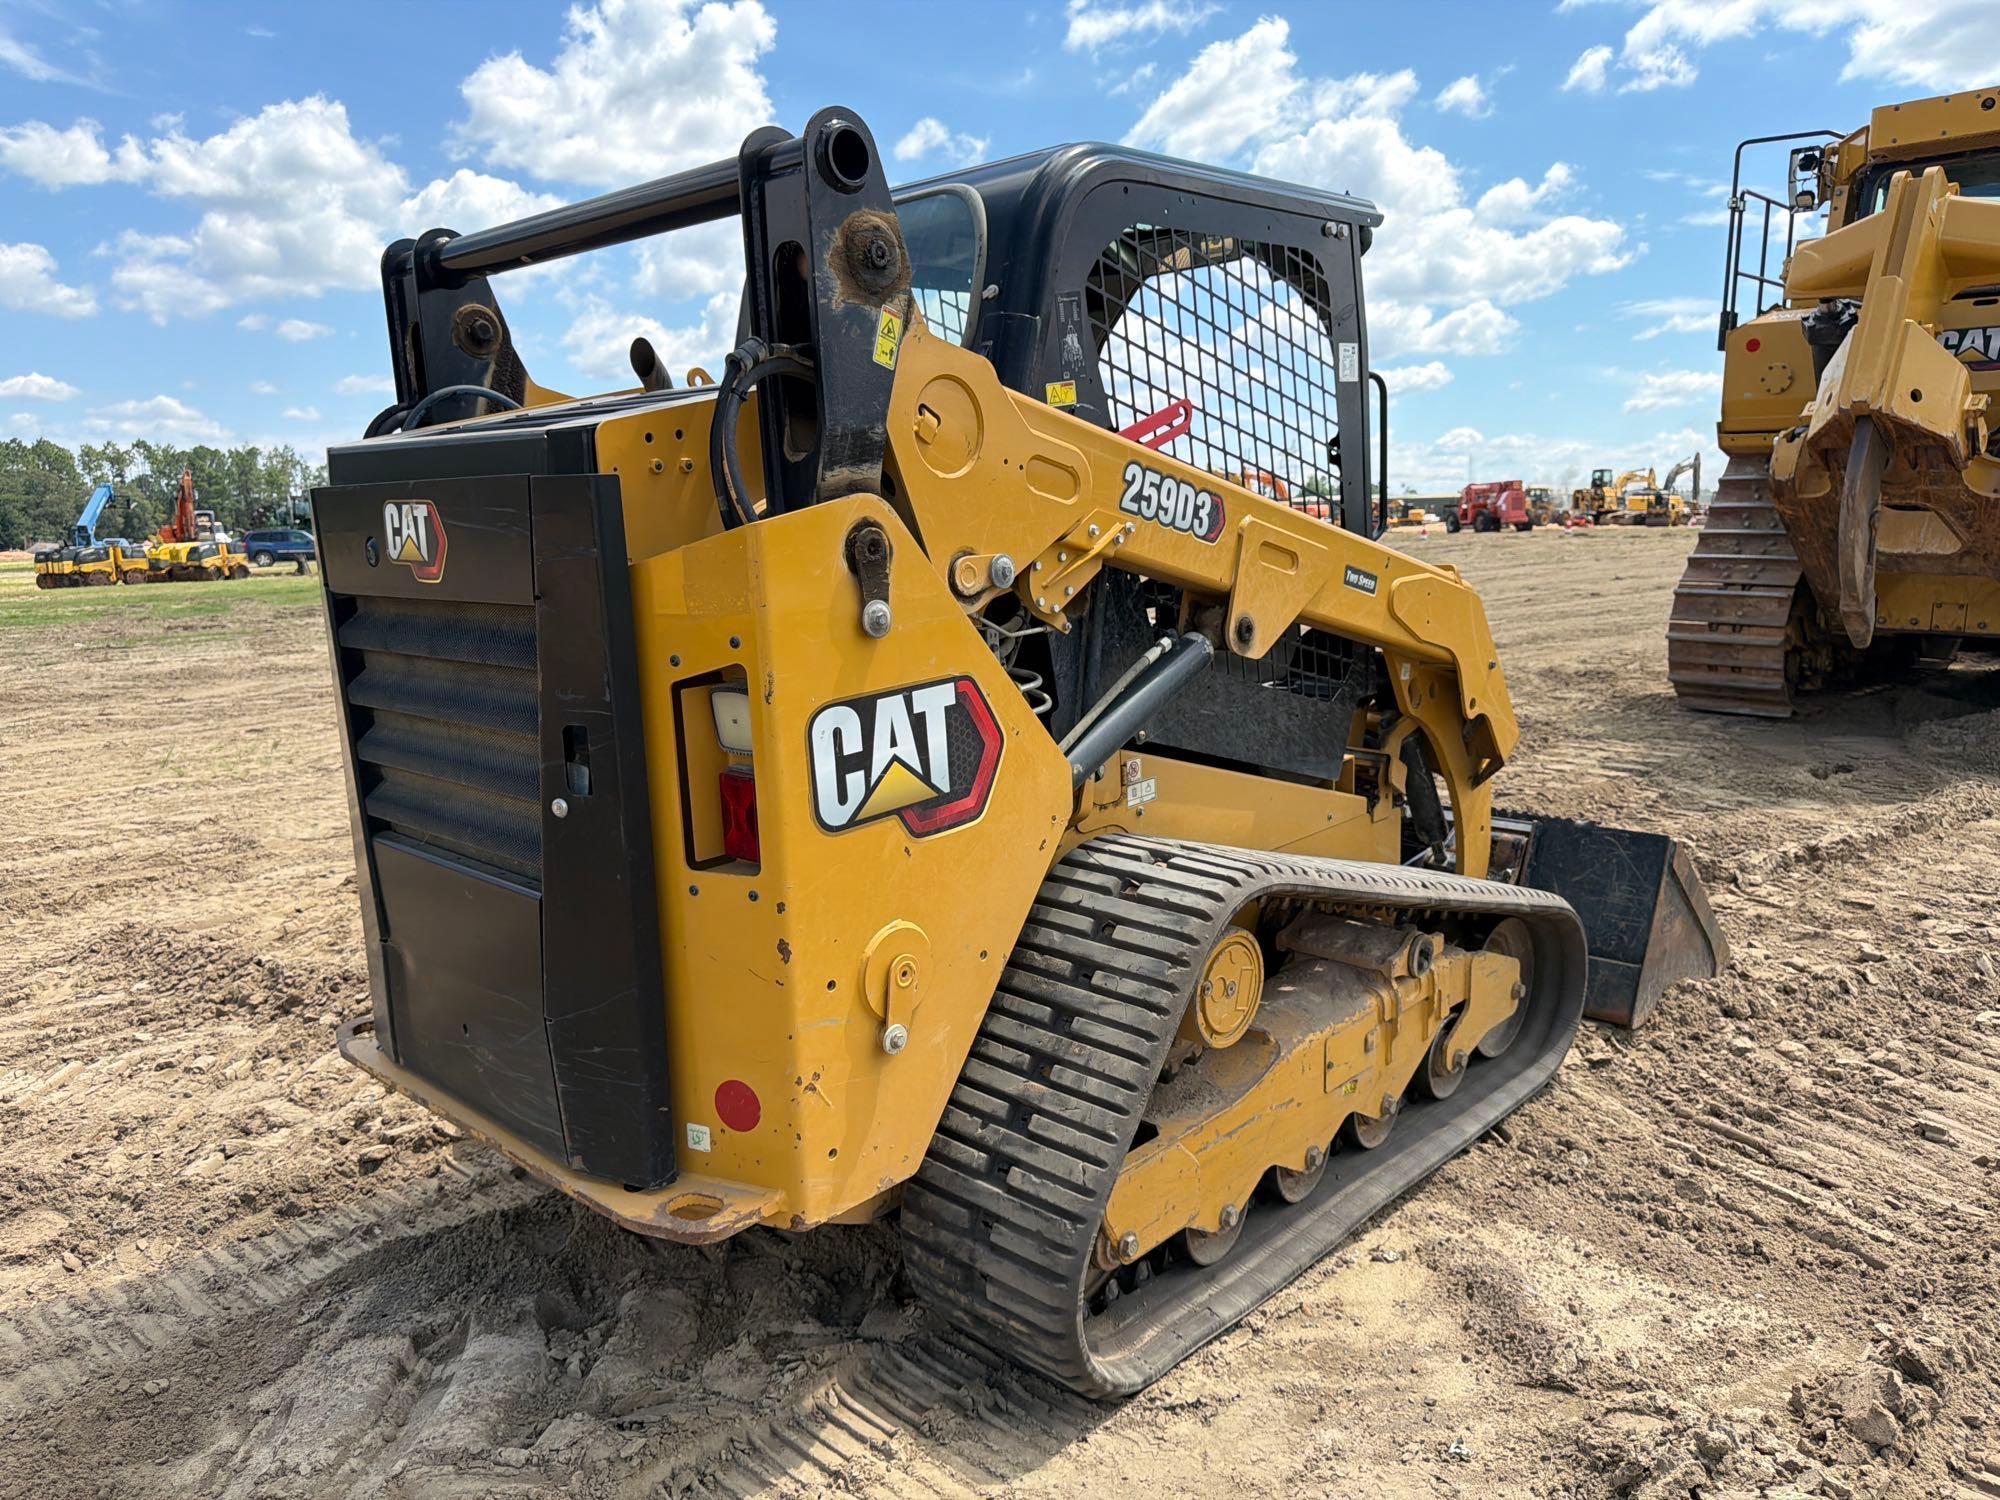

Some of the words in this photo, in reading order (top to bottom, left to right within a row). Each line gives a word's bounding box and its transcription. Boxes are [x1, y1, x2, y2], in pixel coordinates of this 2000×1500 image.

[384, 503, 429, 562] CAT
[1120, 463, 1212, 537] 259D3
[811, 682, 956, 827] CAT
